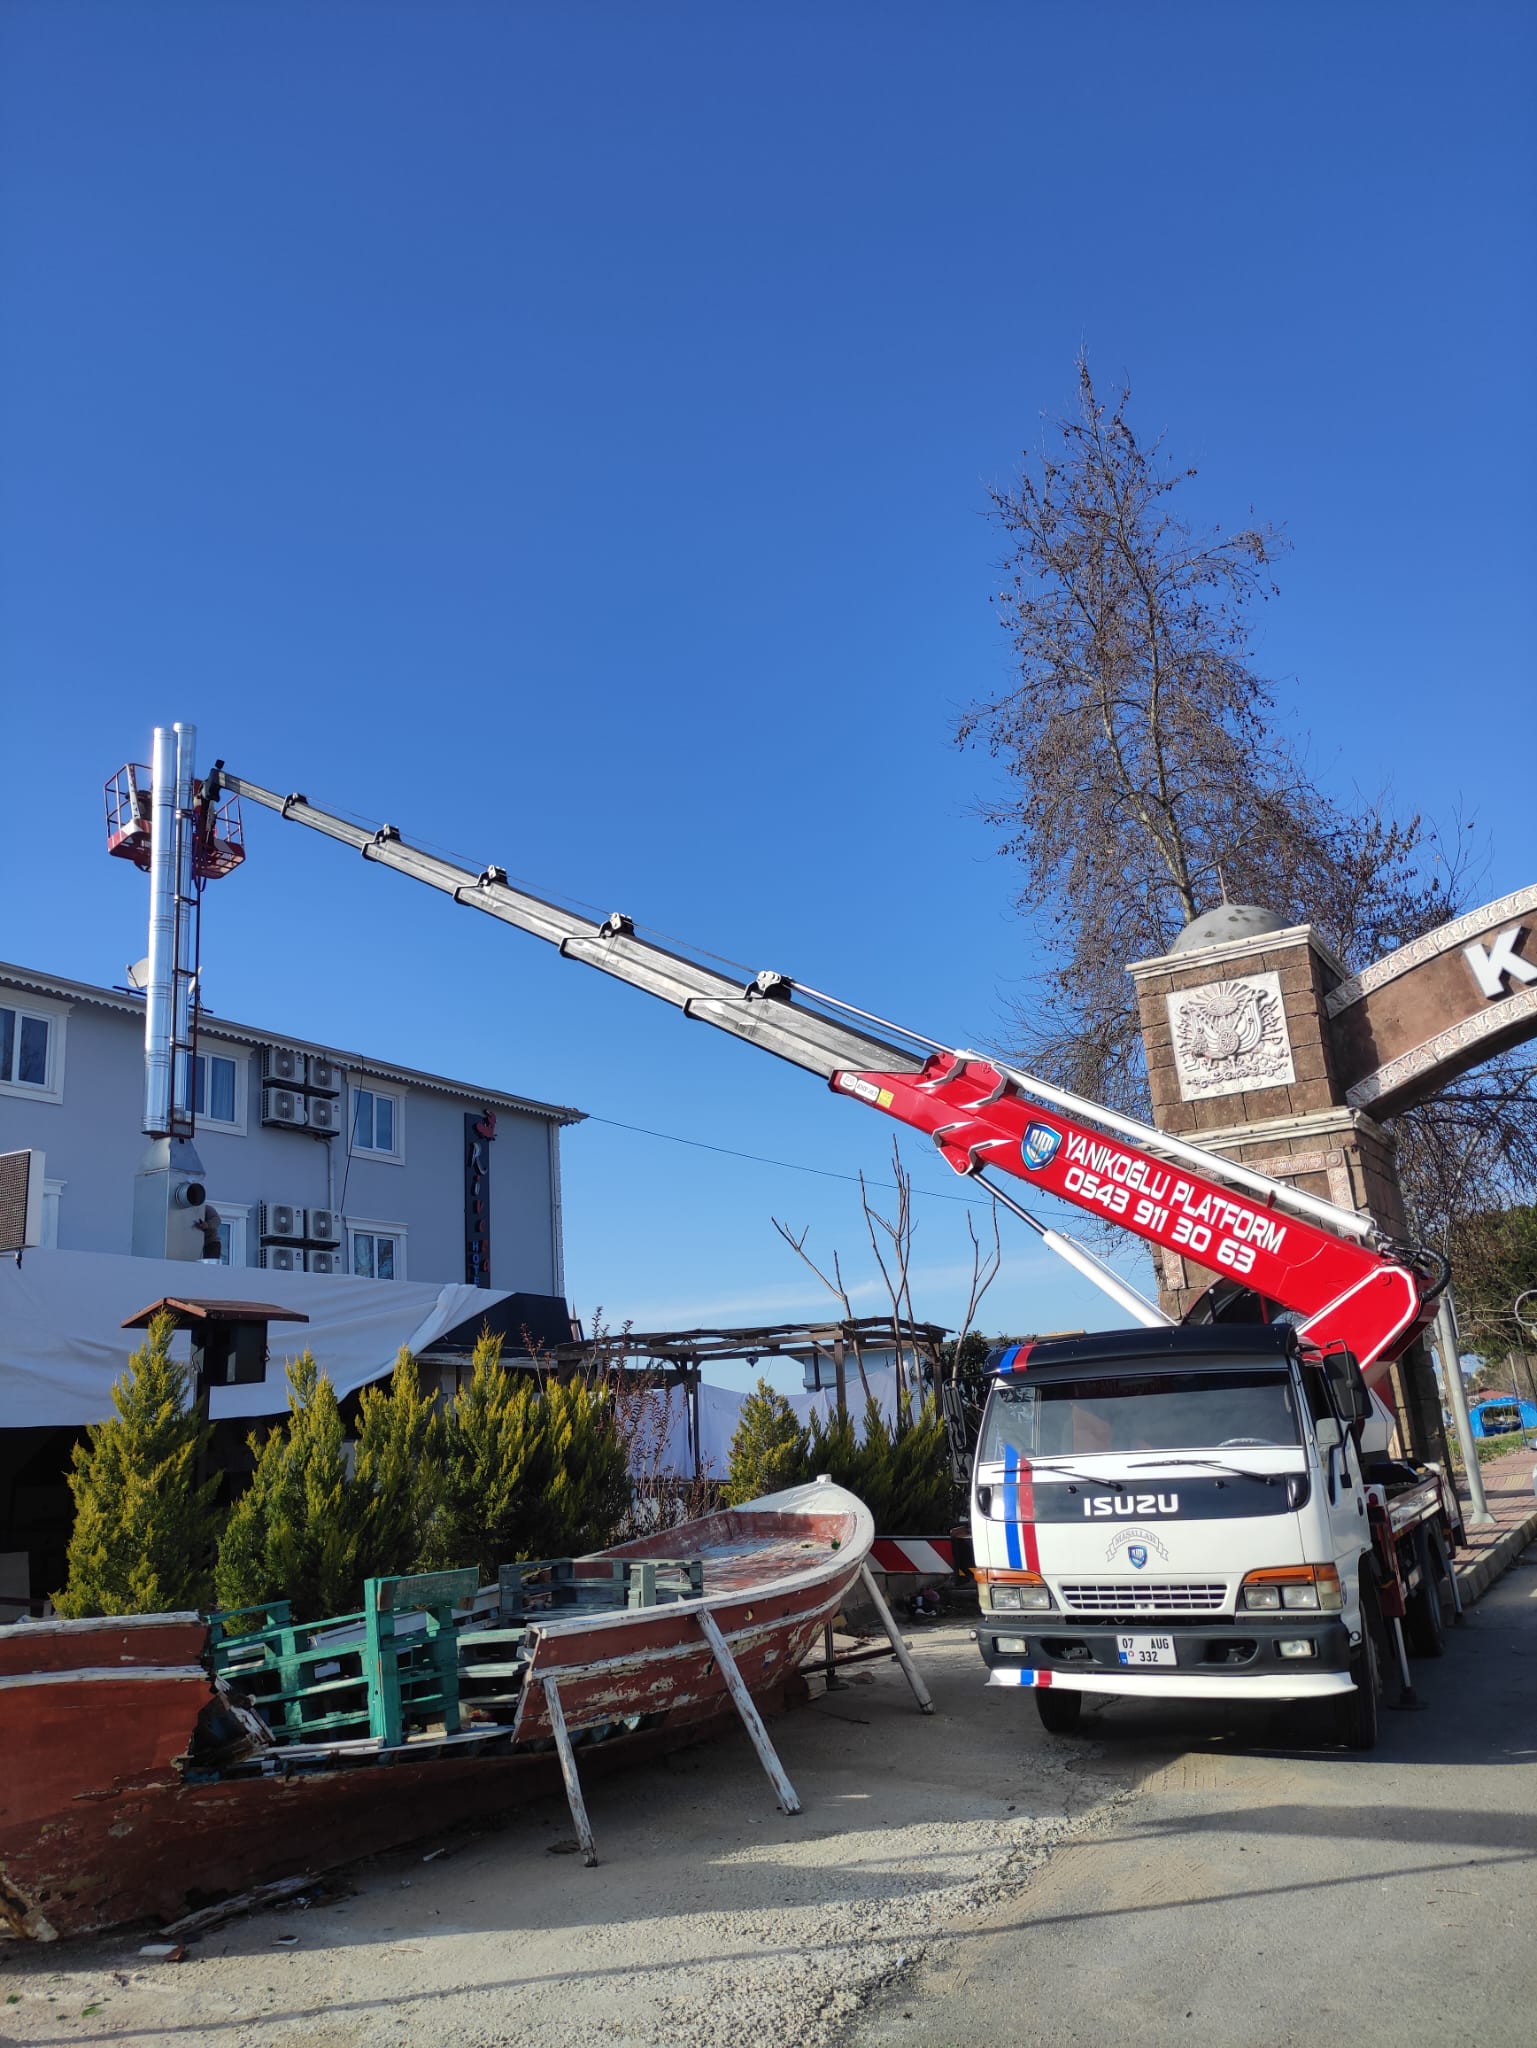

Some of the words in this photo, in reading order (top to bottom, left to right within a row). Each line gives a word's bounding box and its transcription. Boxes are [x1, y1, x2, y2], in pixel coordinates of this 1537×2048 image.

[1463, 926, 1537, 997] K
[1065, 1131, 1171, 1200] YANIKOĞLU
[1169, 1180, 1287, 1255] PLATFORM
[1064, 1166, 1130, 1214] 0543
[1133, 1199, 1170, 1234] 911
[1171, 1216, 1212, 1253] 30
[1217, 1238, 1256, 1274] 63
[1083, 1493, 1179, 1516] ISUZU
[1122, 1637, 1134, 1649] 07
[1150, 1637, 1169, 1649] AUG
[1138, 1650, 1159, 1663] 332
